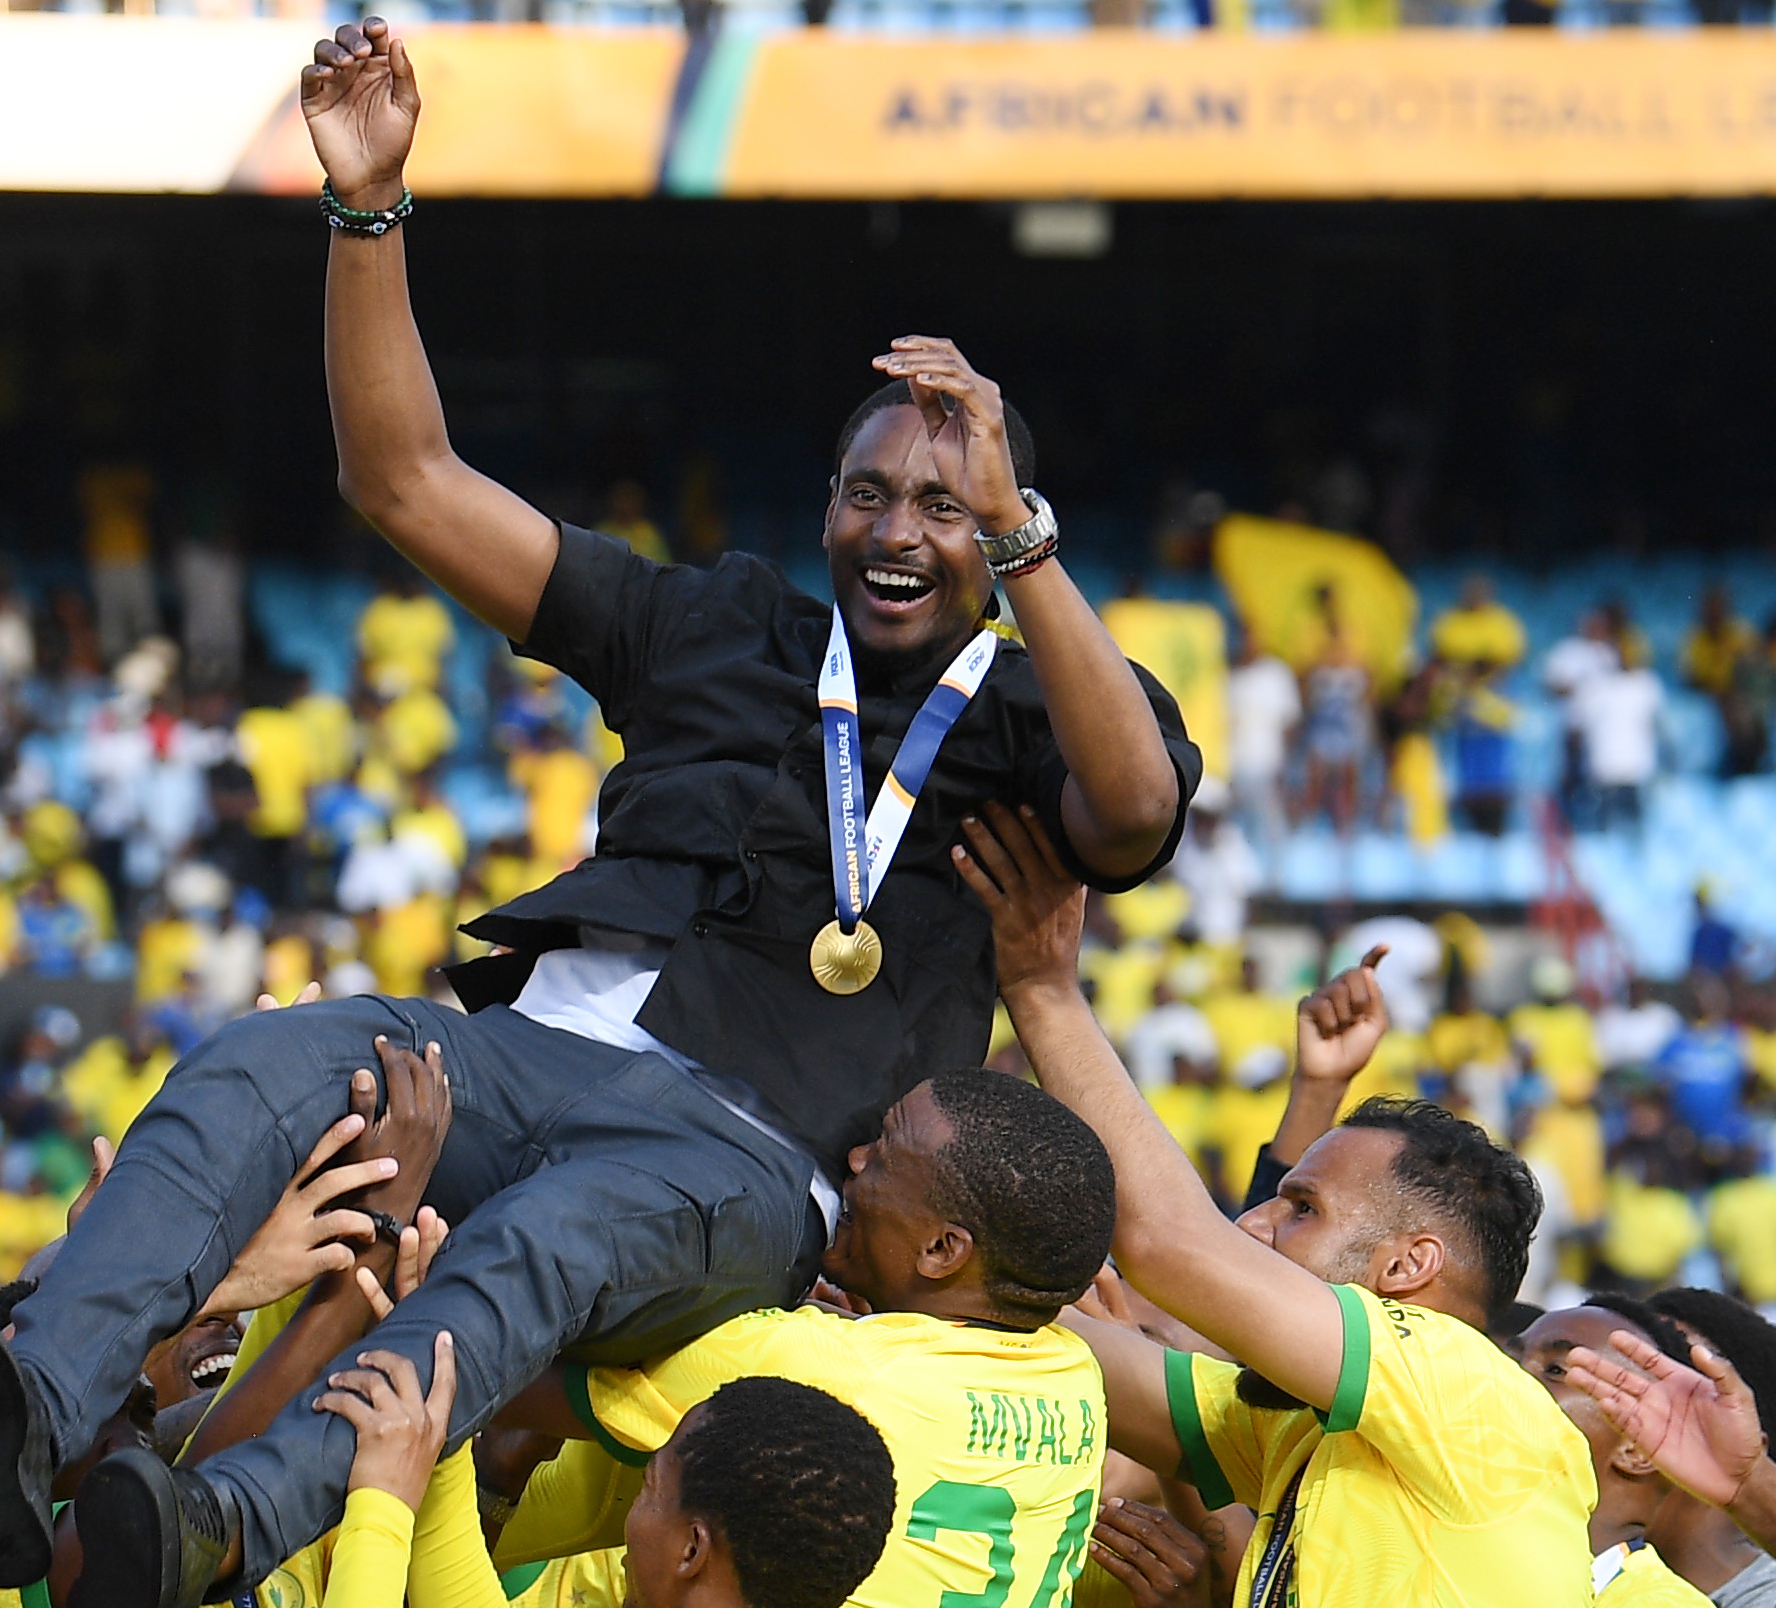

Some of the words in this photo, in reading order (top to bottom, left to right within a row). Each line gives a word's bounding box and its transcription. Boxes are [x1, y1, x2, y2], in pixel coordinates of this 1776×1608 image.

[837, 721, 852, 774] LEAGUE
[839, 775, 857, 848] FOOTBALL
[845, 850, 862, 913] AFRICAN
[966, 1391, 1096, 1466] MVALA
